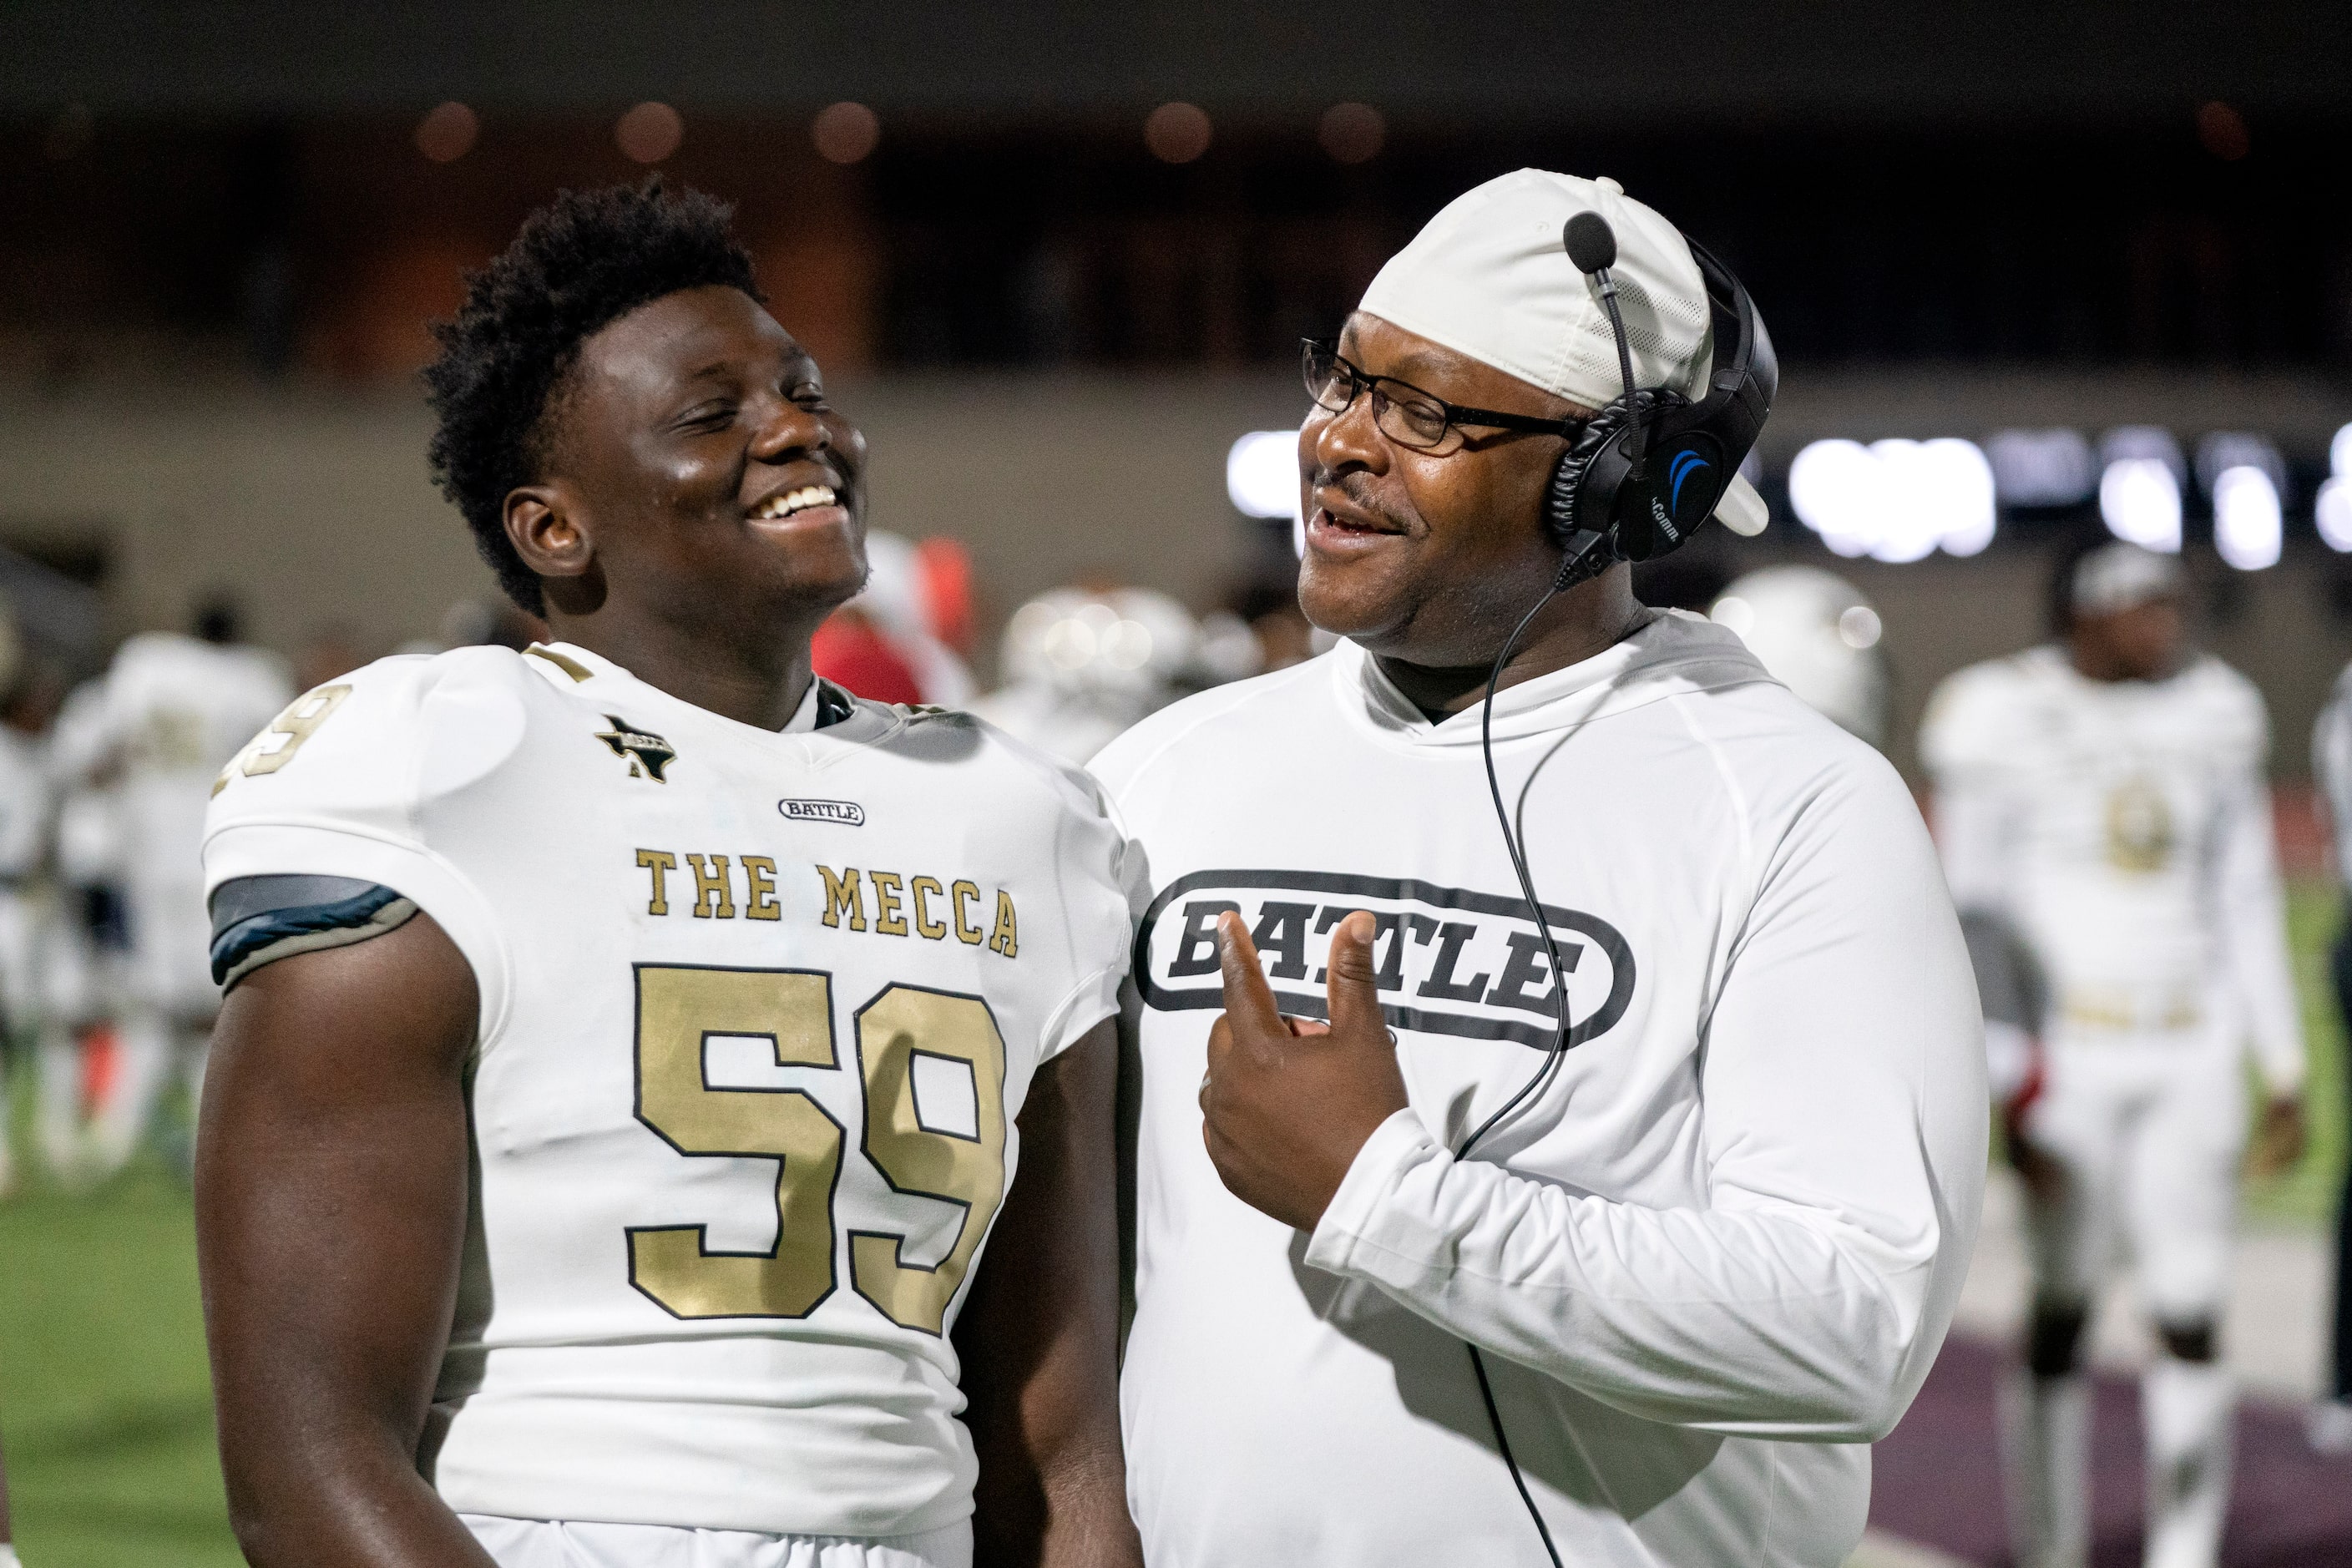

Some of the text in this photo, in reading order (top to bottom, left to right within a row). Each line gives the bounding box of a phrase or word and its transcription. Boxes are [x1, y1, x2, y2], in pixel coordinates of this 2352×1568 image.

[787, 802, 857, 821] BATTLE
[636, 848, 1018, 959] THE MECCA
[624, 962, 1007, 1339] 59
